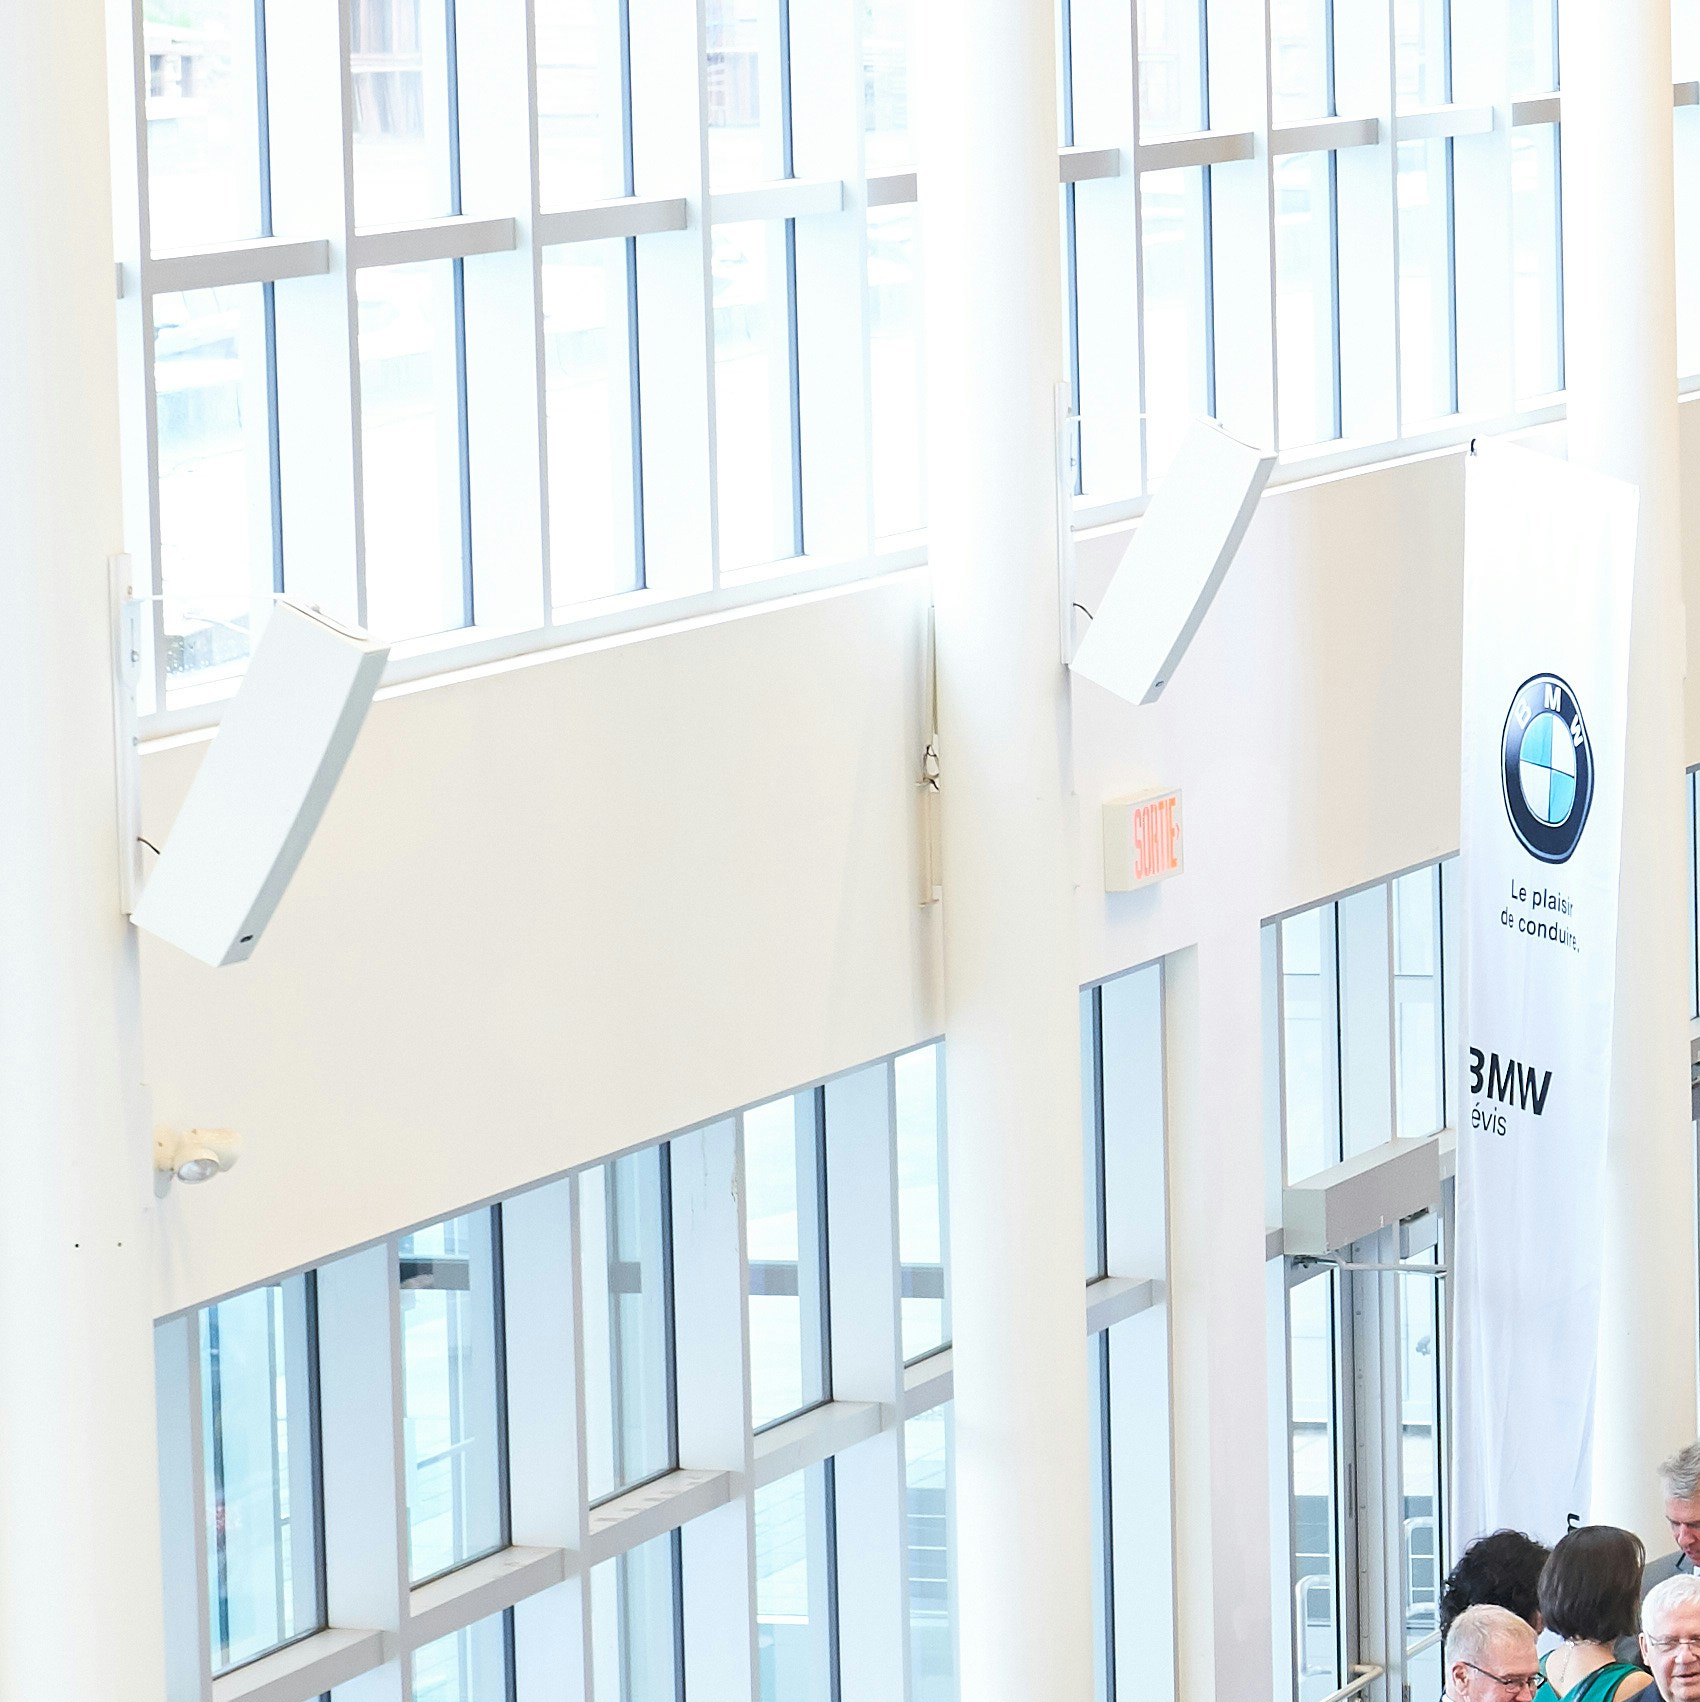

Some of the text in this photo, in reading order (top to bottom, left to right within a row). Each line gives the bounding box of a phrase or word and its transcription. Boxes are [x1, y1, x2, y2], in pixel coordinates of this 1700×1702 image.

[1513, 683, 1584, 748] BMW
[1134, 796, 1178, 881] SORTIE
[1500, 906, 1515, 928] de
[1511, 878, 1574, 918] Le plaisir
